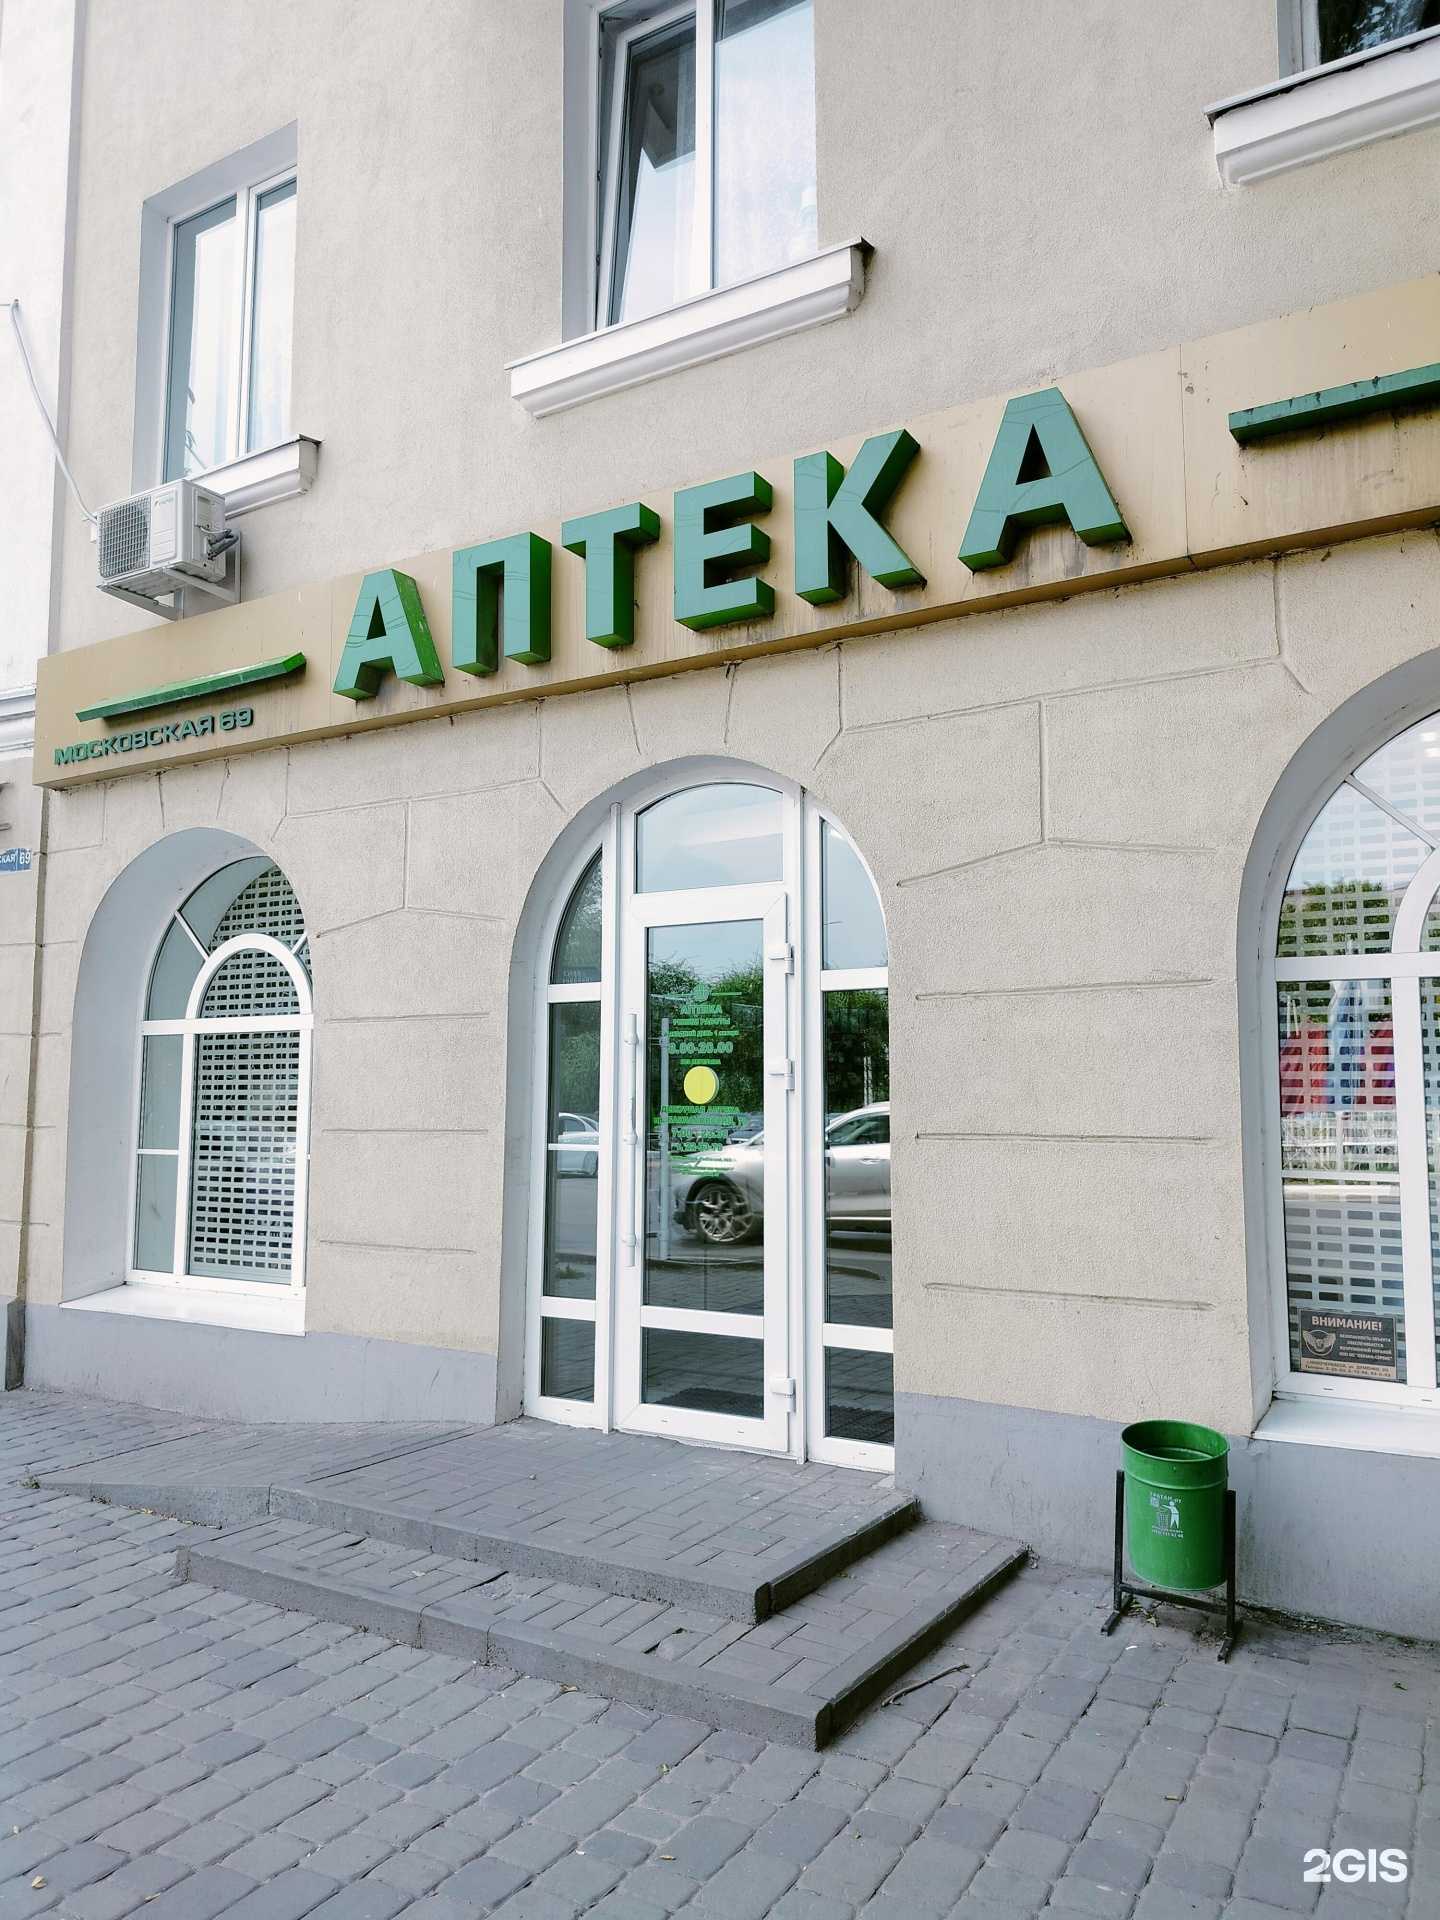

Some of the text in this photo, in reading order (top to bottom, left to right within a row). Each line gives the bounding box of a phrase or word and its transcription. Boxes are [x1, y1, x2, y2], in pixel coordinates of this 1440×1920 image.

[333, 387, 1132, 701] АПТЕКА
[54, 707, 254, 765] МОСКОВСКАЯ 69
[19, 852, 31, 865] 69
[1311, 1315, 1382, 1332] ВНИМАНИЕ!
